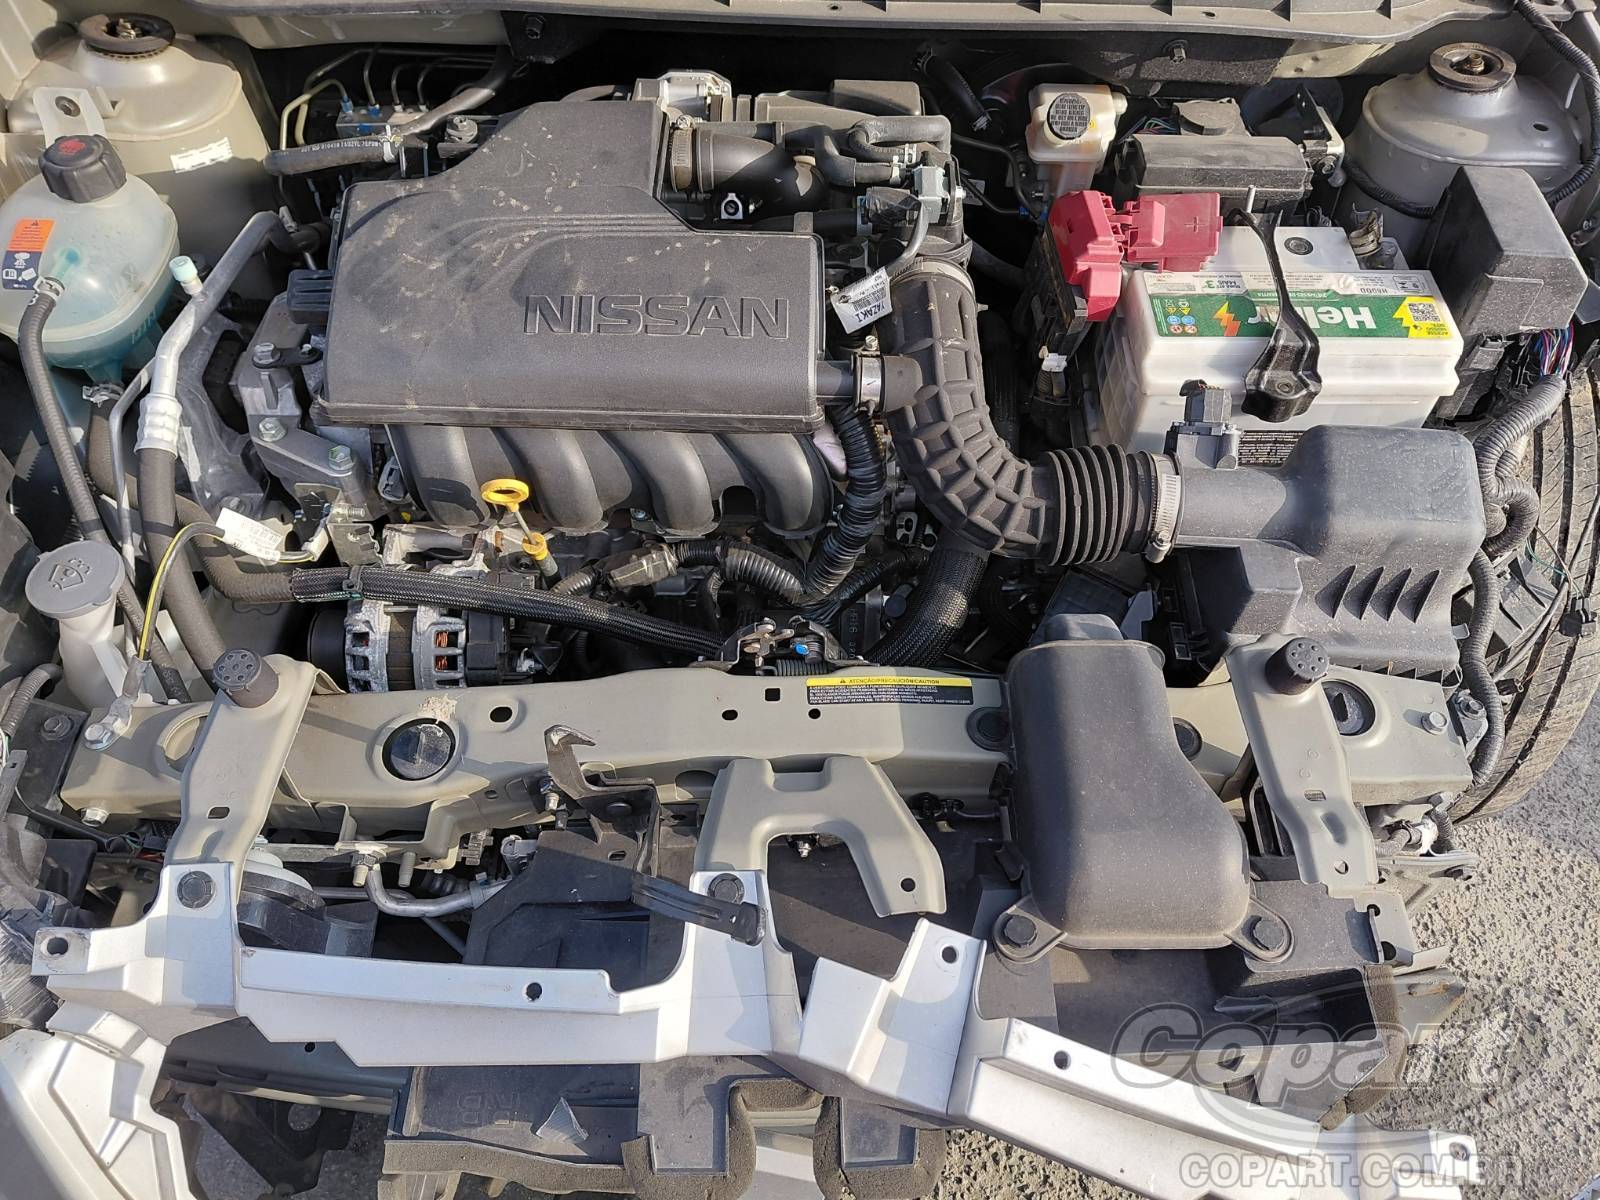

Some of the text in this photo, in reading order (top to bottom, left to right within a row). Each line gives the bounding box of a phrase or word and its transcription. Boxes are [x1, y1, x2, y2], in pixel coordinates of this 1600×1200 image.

[523, 294, 789, 340] NISSAN
[855, 300, 886, 323] YAZAKI
[1246, 306, 1377, 330] Helar
